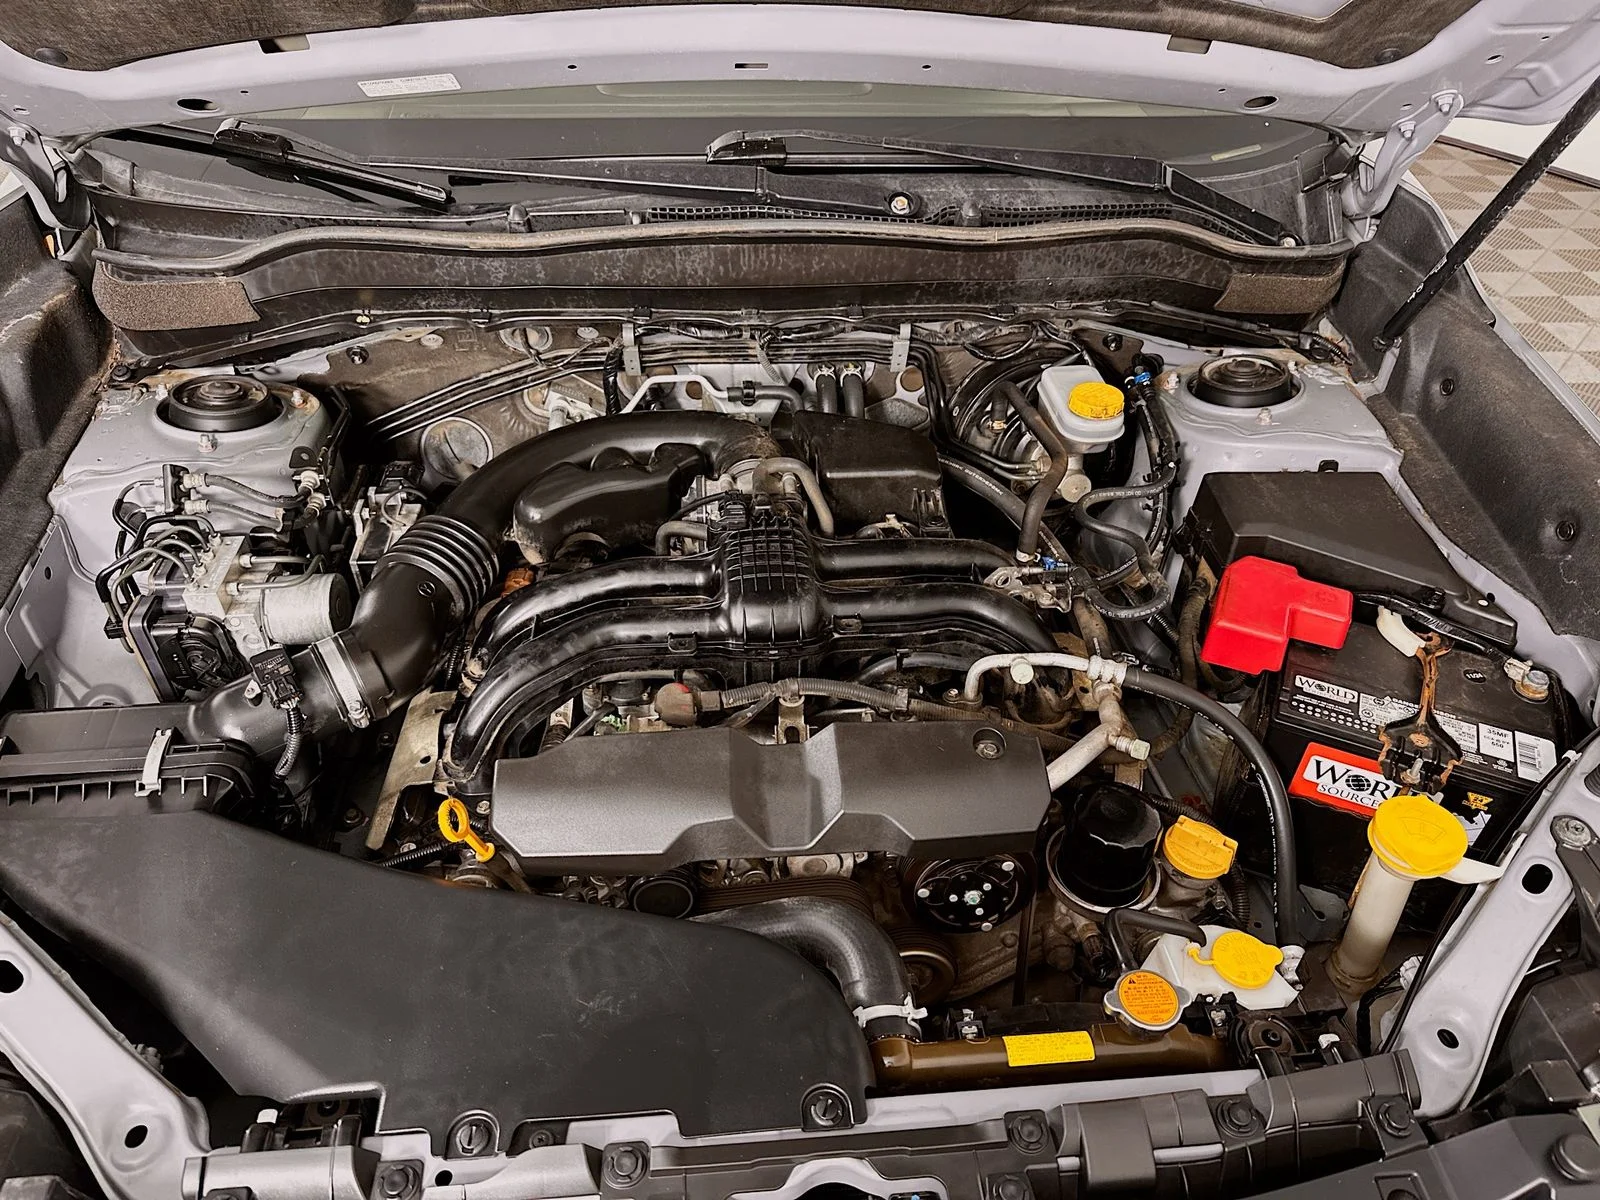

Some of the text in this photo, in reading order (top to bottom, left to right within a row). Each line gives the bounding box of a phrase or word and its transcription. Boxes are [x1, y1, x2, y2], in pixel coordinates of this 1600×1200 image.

[1299, 677, 1356, 700] WORLD
[1393, 697, 1419, 708] DANGE
[1319, 784, 1380, 807] SOURCE
